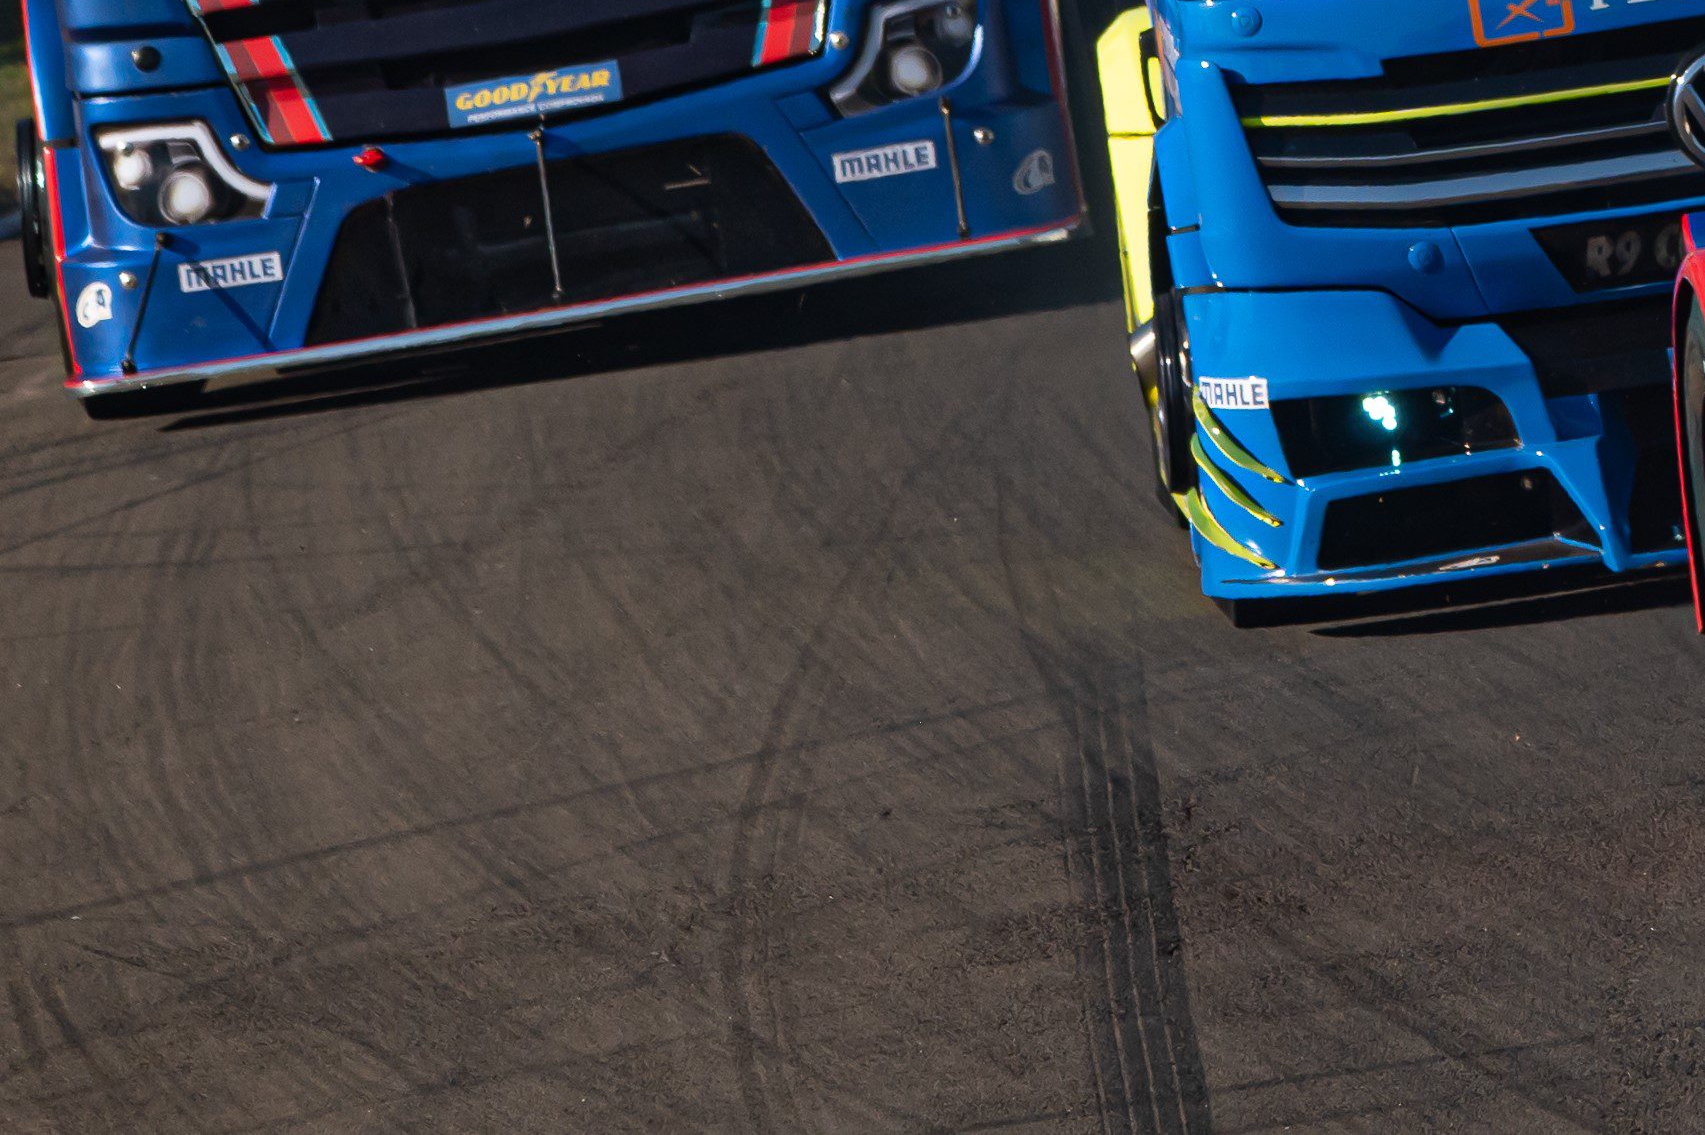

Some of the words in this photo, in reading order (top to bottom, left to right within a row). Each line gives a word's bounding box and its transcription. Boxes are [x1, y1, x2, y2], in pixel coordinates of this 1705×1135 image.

[839, 144, 930, 179] MAHLE
[184, 262, 277, 290] MAHLE
[1203, 382, 1267, 408] MAHLE
